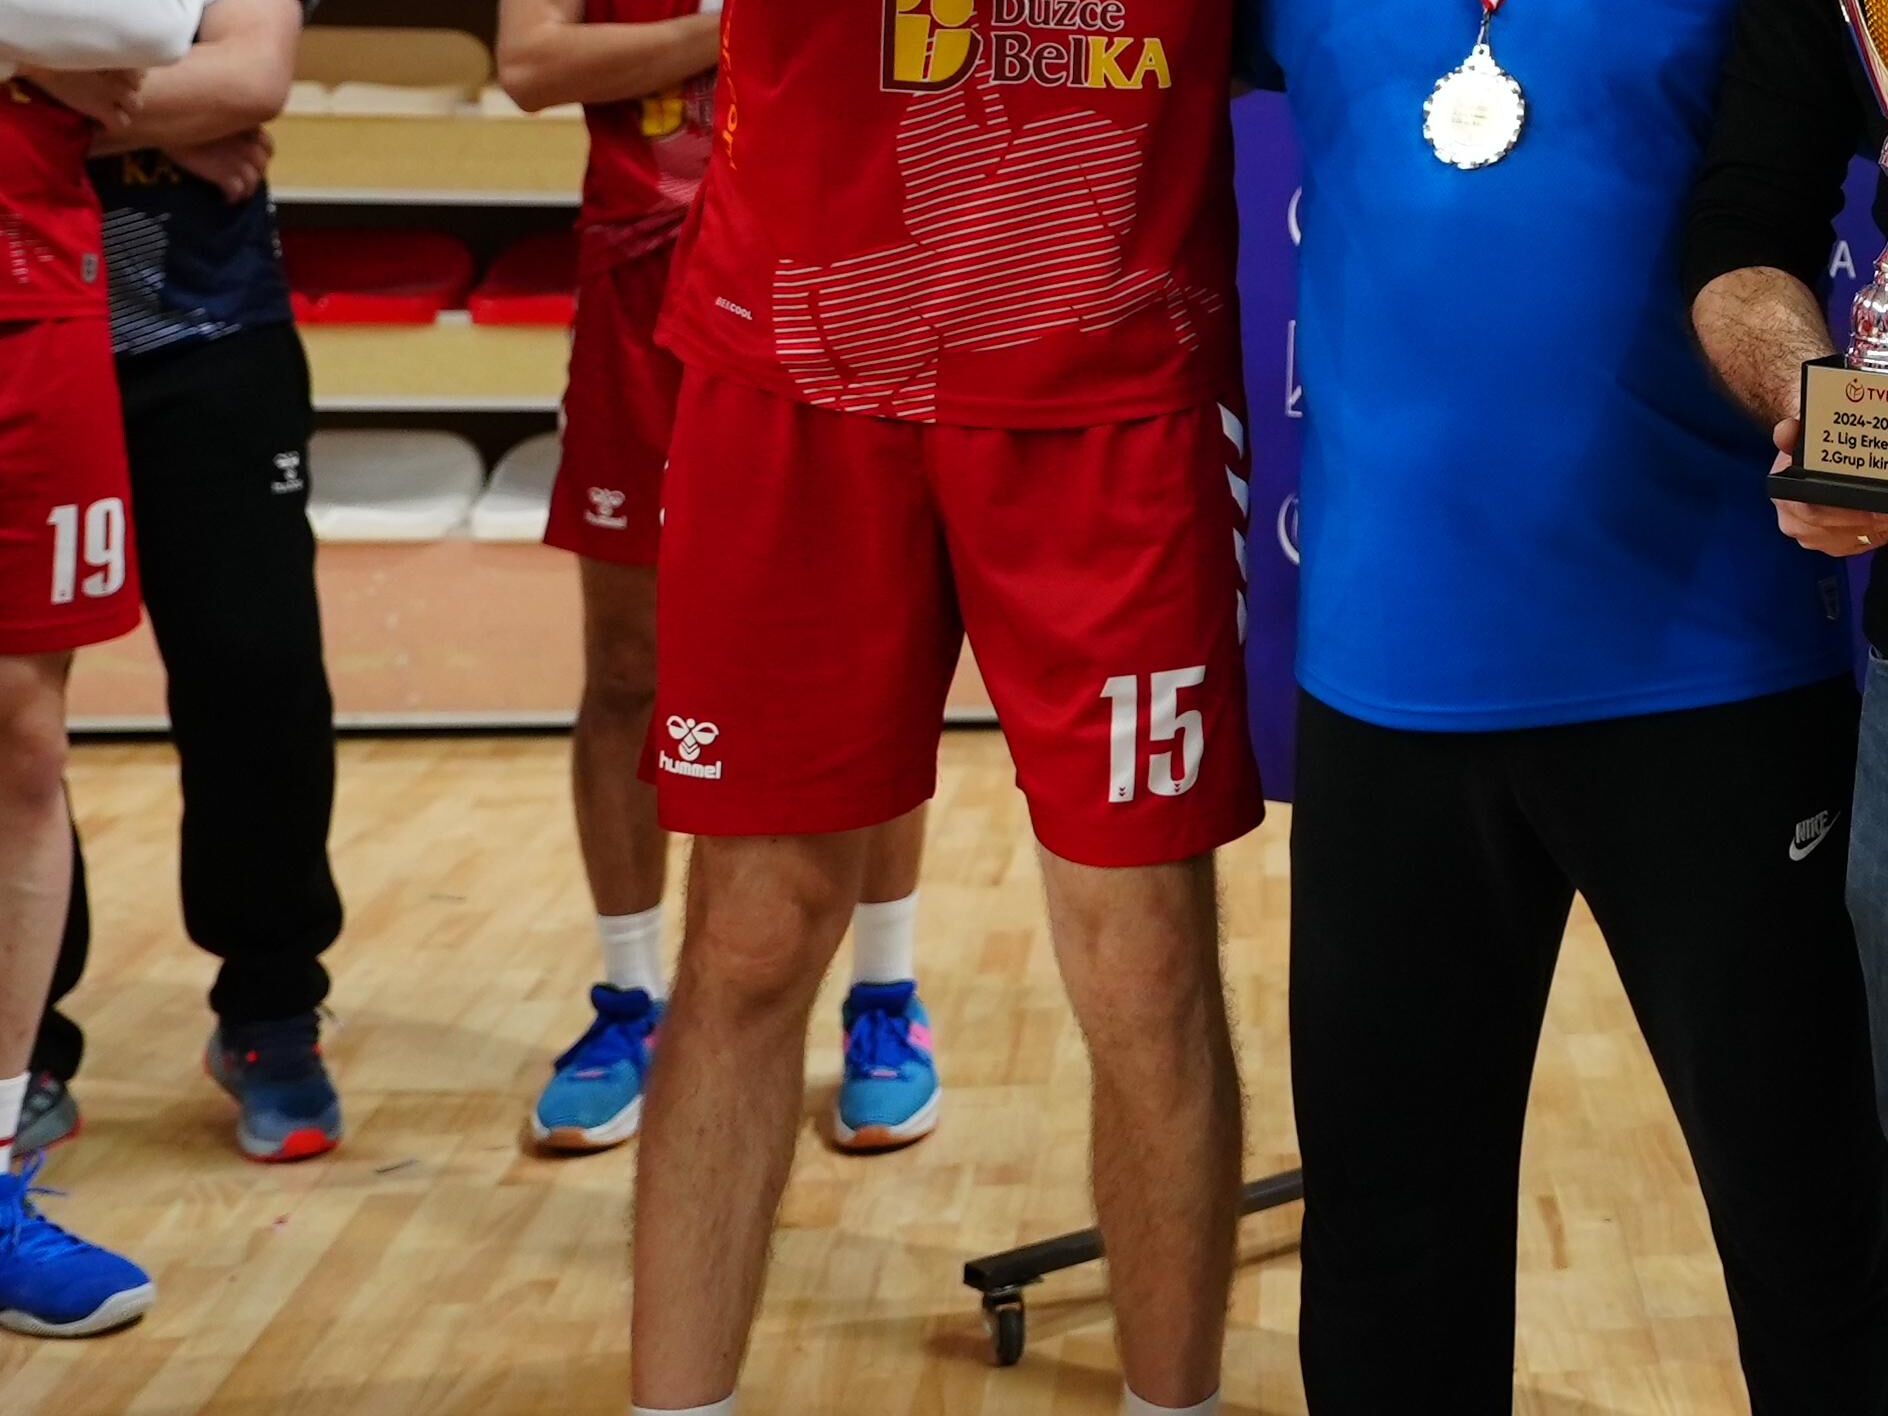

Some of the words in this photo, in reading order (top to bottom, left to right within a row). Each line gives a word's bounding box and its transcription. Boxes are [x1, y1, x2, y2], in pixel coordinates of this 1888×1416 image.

[989, 30, 1172, 89] BelKA
[1821, 449, 1865, 469] 2.Grup
[1822, 430, 1834, 443] 2.
[1838, 432, 1857, 449] Lig
[47, 498, 126, 604] 19
[1100, 666, 1206, 803] 15
[659, 750, 722, 779] hummel
